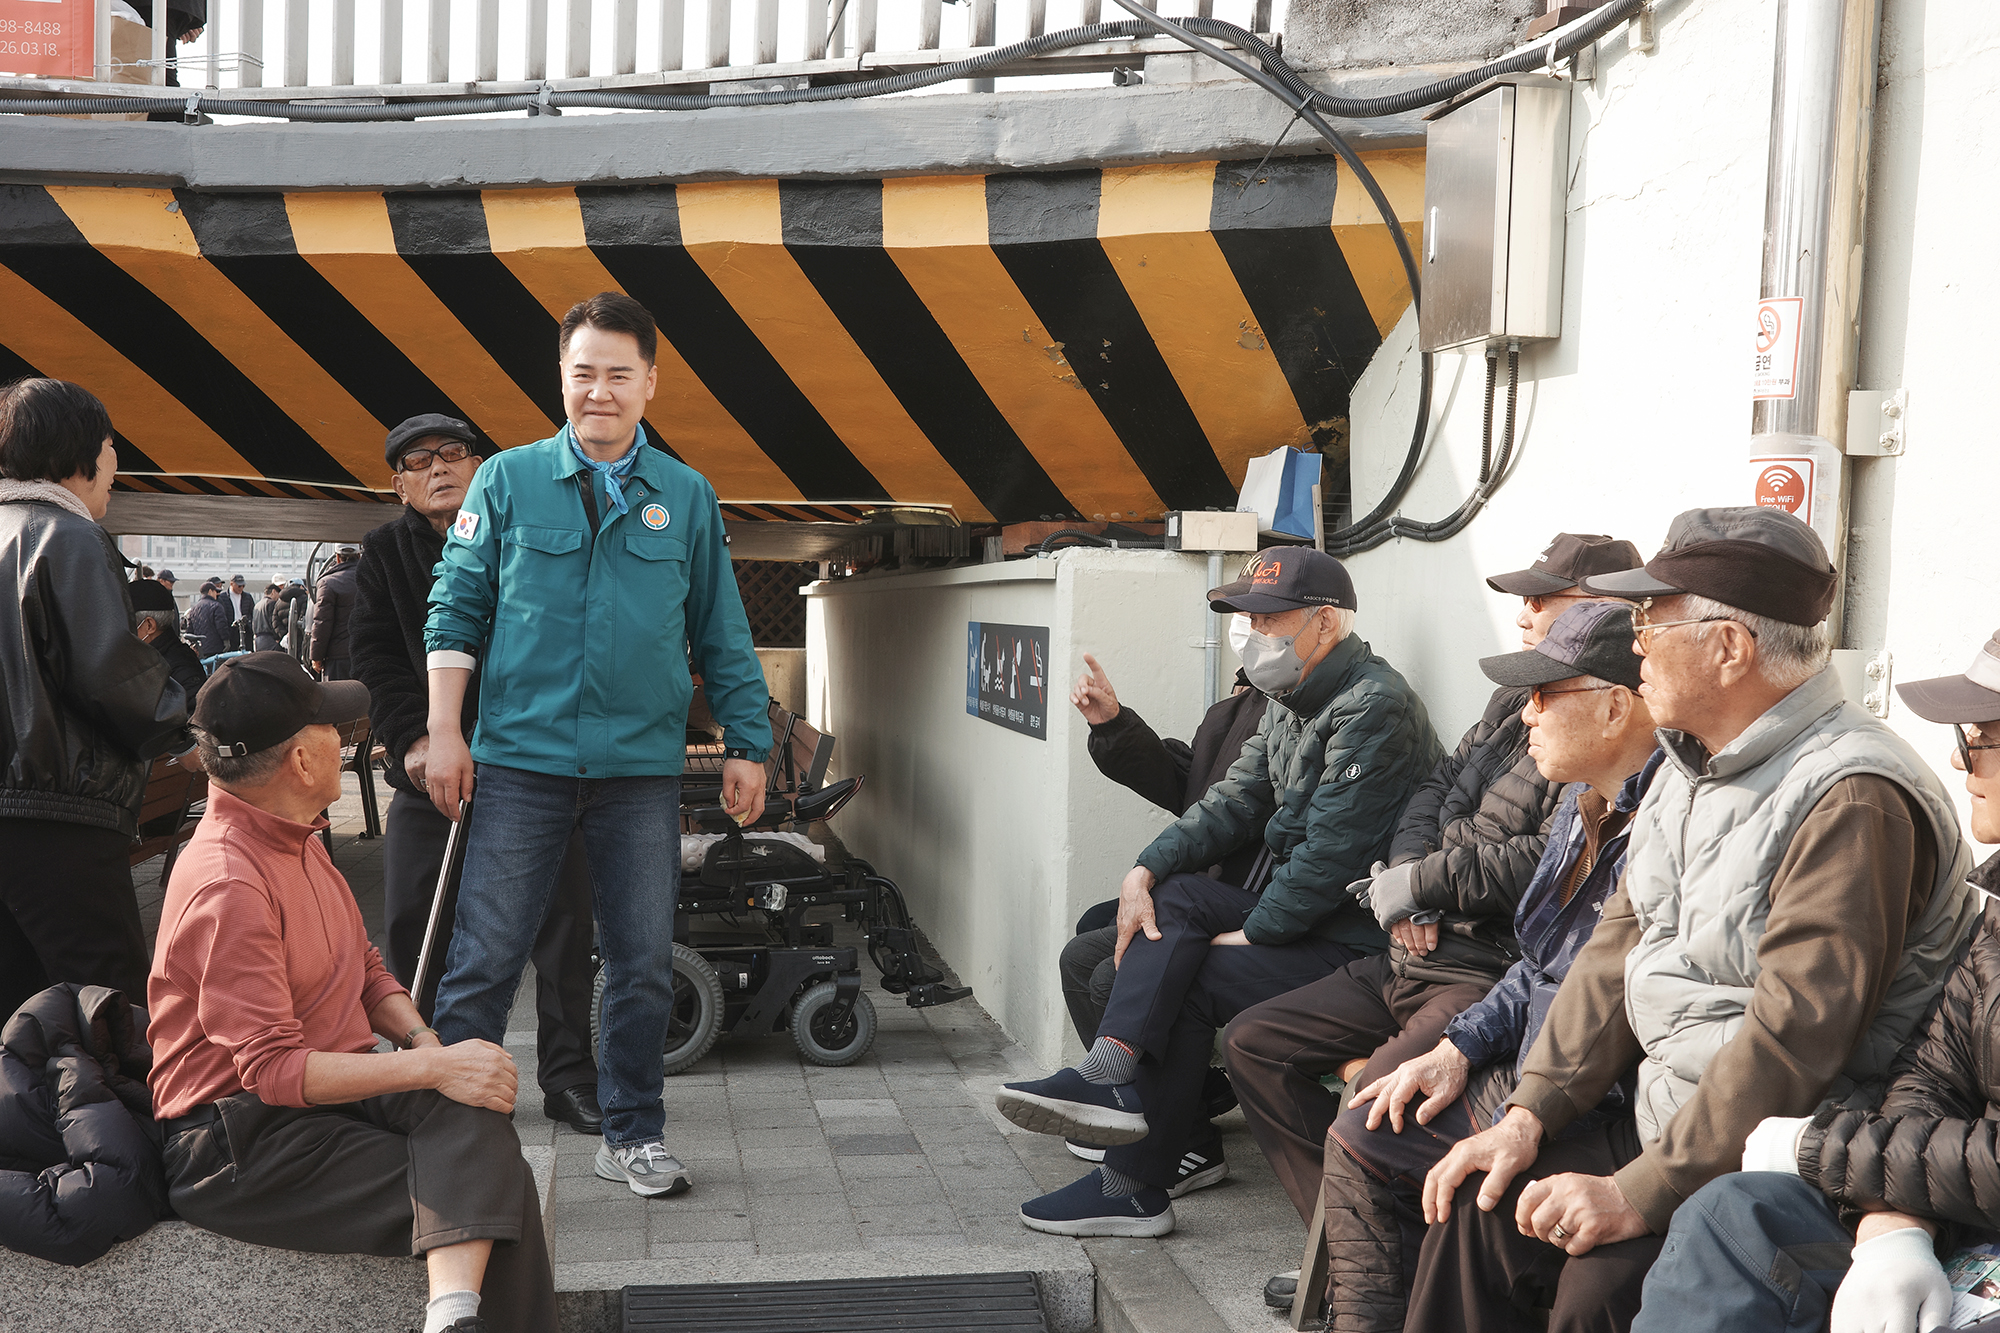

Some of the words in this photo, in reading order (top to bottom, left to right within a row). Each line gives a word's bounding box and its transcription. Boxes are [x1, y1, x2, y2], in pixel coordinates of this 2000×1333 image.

[0, 19, 61, 36] 98-8488
[0, 40, 61, 57] 26.03.18.
[1760, 495, 1776, 503] Free
[1777, 495, 1795, 503] WiFi
